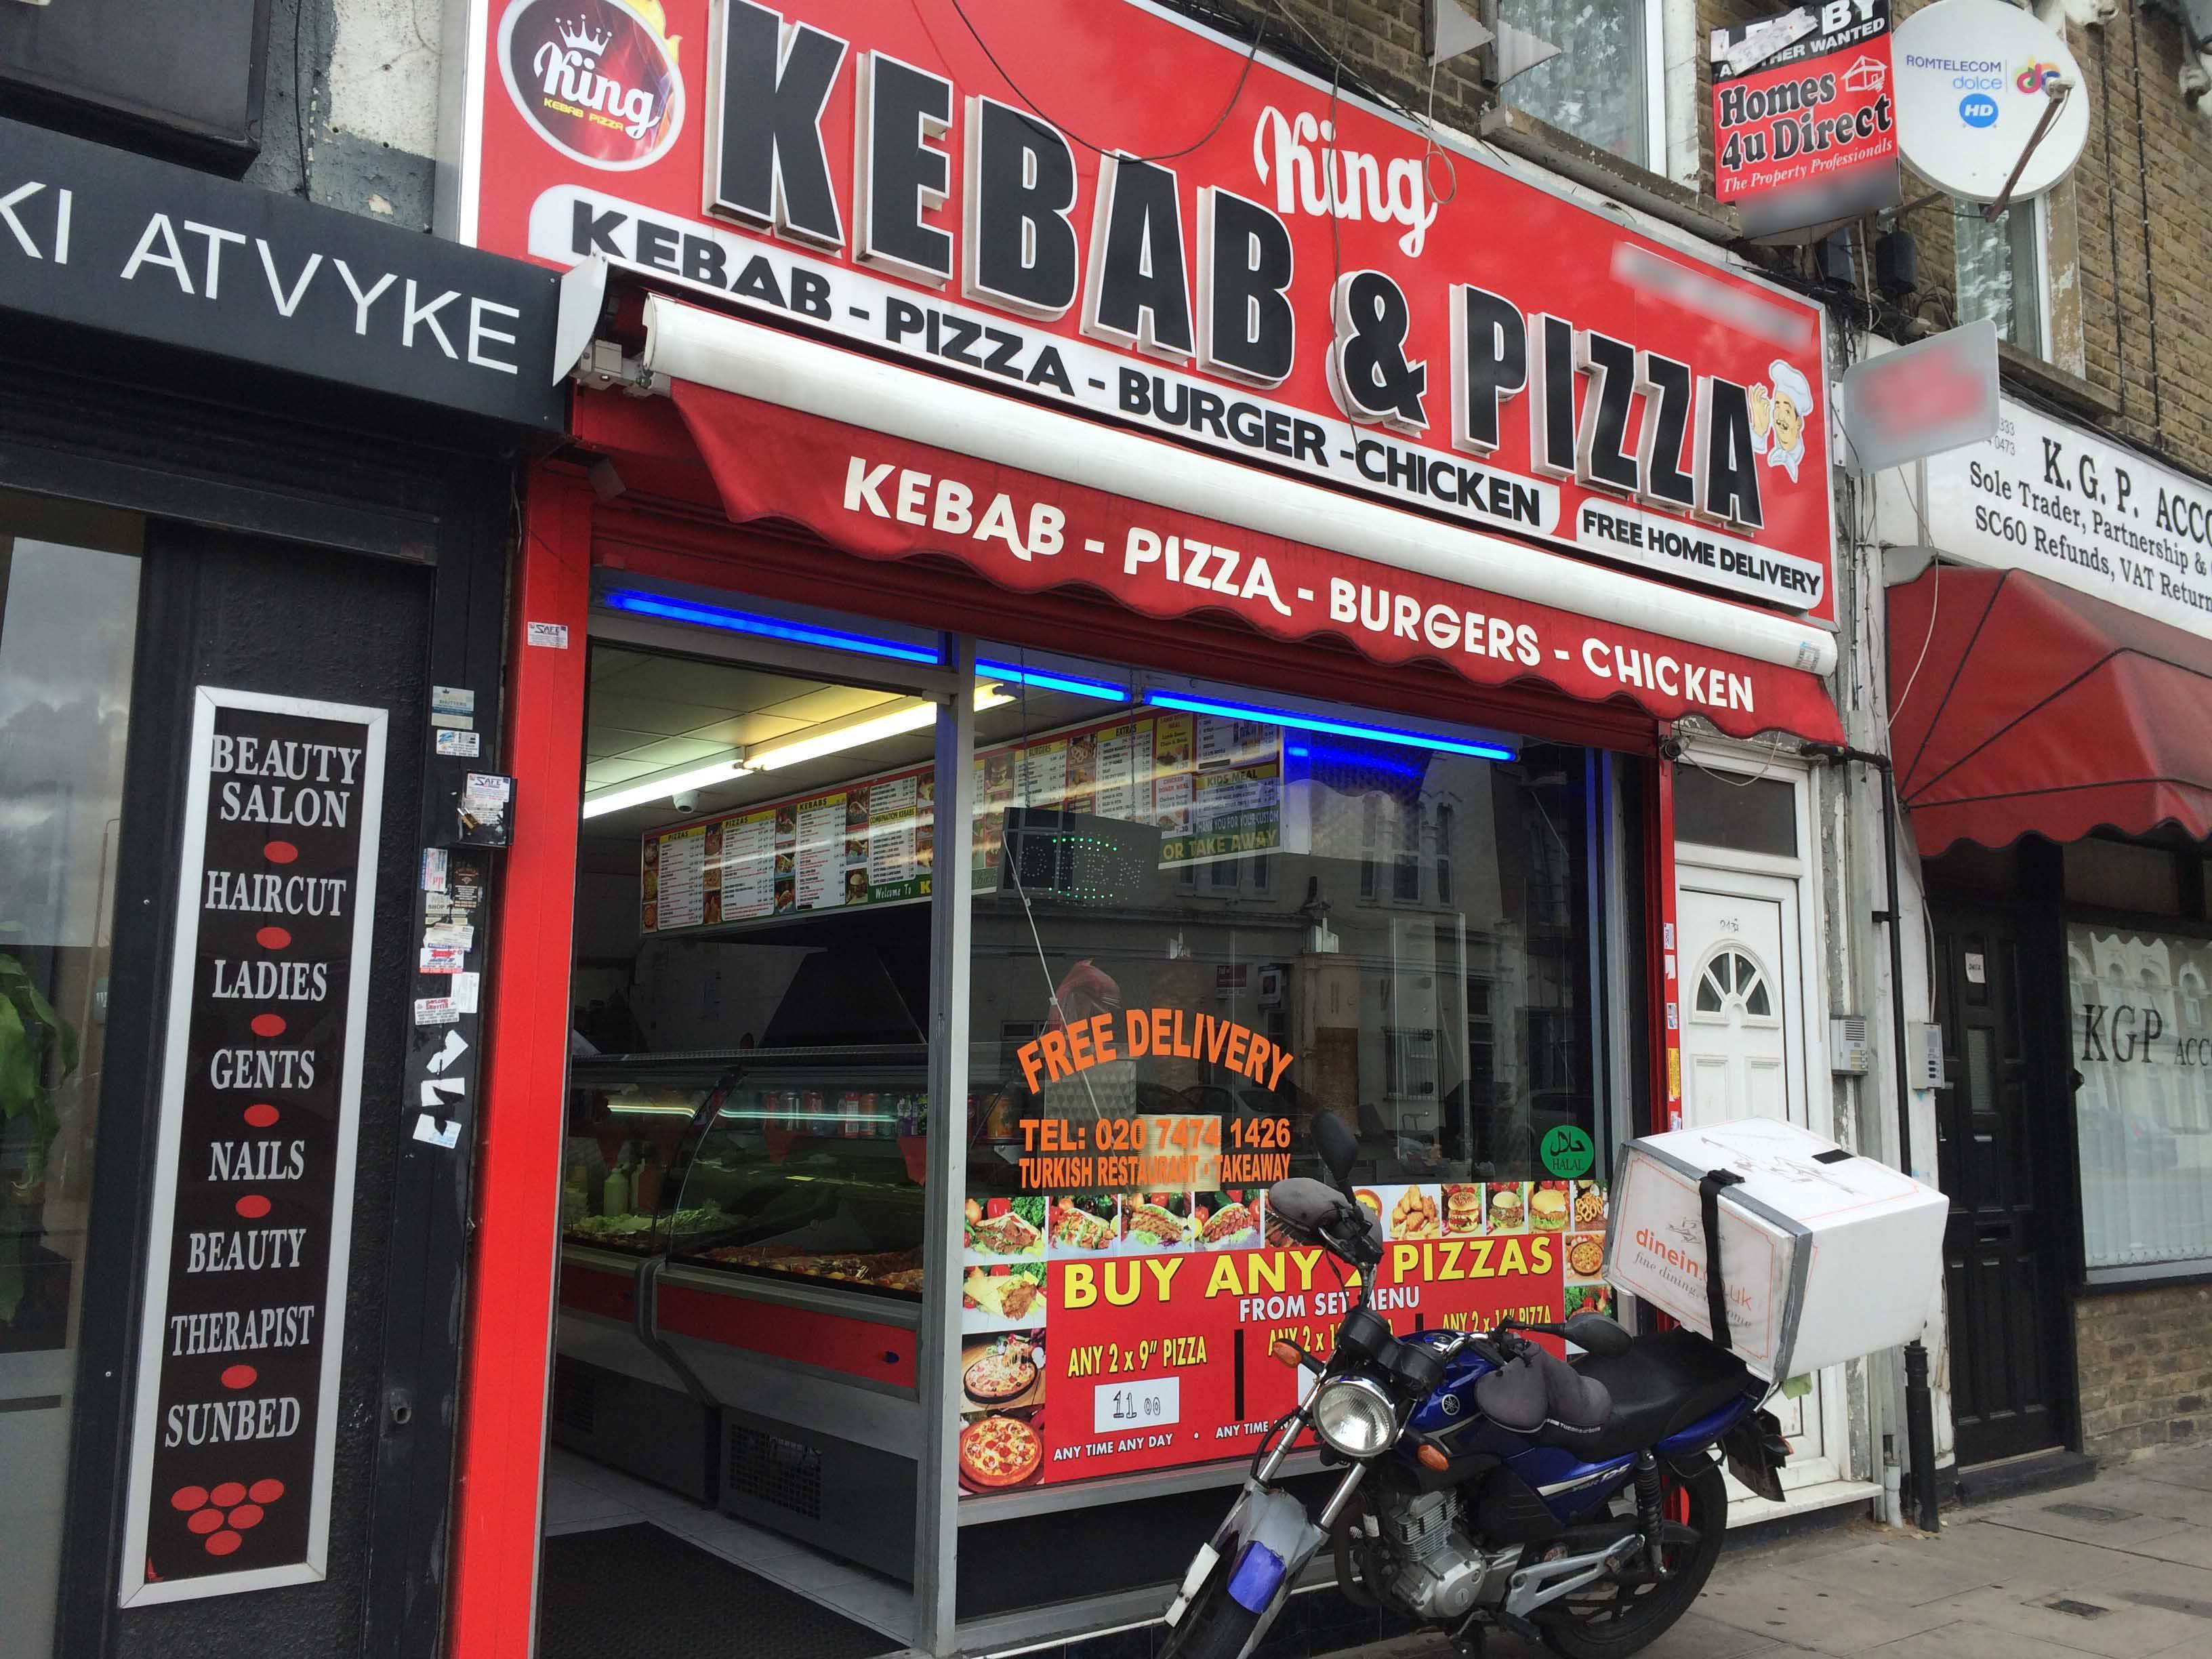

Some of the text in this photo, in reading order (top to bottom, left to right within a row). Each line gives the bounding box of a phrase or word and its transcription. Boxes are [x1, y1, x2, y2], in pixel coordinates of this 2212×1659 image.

[1719, 44, 1805, 77] AHER
[1810, 18, 1885, 54] WANTED
[1906, 54, 2002, 73] ROMTELECOM
[533, 41, 661, 140] King
[1719, 73, 1836, 128] Homes
[1952, 76, 2003, 90] dolce
[544, 97, 624, 132] KEBAB PIZZA
[1965, 104, 1994, 117] HD
[1721, 94, 1893, 173] 4u Direct
[1253, 104, 1439, 258] King
[1723, 138, 1893, 192] The Property Professionals
[705, 0, 1764, 533] KEBAB & PIZZA
[119, 213, 520, 375] ATVYKE
[572, 200, 832, 322] KEBAB
[885, 296, 1076, 396] PIZZA
[1118, 366, 1328, 468] BURGER
[1994, 434, 2016, 456] 0473
[1969, 462, 2012, 500] Sole
[2018, 480, 2087, 535] Trader,
[2092, 510, 2188, 575] Partnership
[2194, 552, 2207, 576] &
[1582, 510, 1821, 596] FREE HOME DELIVERY
[1975, 505, 2027, 546] SC60
[2033, 526, 2115, 582] Refunds,
[2119, 557, 2154, 592] VAT
[842, 456, 1066, 562] KEBAB
[1123, 526, 1292, 617] PIZZA
[1330, 577, 1540, 667] BURGERS
[1582, 637, 1755, 713] CHICKEN
[1029, 745, 1052, 756] BURGERS
[1115, 724, 1137, 739] EXTRAS
[209, 734, 362, 785] BEAUTY
[1207, 769, 1257, 787] KIDS MEAL
[475, 777, 501, 787] SAFE
[220, 781, 351, 829] SALON
[725, 817, 748, 827] PIZZAS
[799, 797, 827, 811] KEBABS
[1196, 819, 1213, 834] THANK
[1214, 818, 1227, 830] YOU
[1227, 816, 1240, 828] FOR
[668, 831, 689, 841] PIZZAS
[1163, 829, 1277, 860] OR TAKE AWAY
[205, 871, 347, 917] HAIRCUT
[875, 883, 912, 899] Welcome To
[211, 959, 328, 1002] LADIES
[1017, 1008, 1294, 1094] FREE DELIVERY
[2082, 1004, 2212, 1067] KGP ACC
[210, 1048, 315, 1090] GENTS
[1019, 1118, 1290, 1151] TEL: 020 7474 1426
[1550, 1129, 1586, 1157] حلال
[207, 1140, 306, 1182] NAILS
[1019, 1153, 1291, 1189] TURKISH RESTAURANT TAKEAWAY
[1552, 1158, 1584, 1171] HALAL
[186, 1228, 307, 1273] BEAUTY
[1633, 1252, 1656, 1270] fine
[1064, 1257, 1185, 1310] BUY
[1204, 1249, 1324, 1299] ANY
[1393, 1237, 1554, 1285] PIZZAS
[1239, 1294, 1306, 1323] FROM
[1314, 1291, 1349, 1316] SET
[1442, 1311, 1469, 1332] ANY
[1471, 1310, 1479, 1332] 2
[1483, 1317, 1490, 1333] x
[1519, 1305, 1552, 1328] PIZZA
[170, 1305, 315, 1356] THERAPIST
[1302, 1325, 1311, 1353] 2
[1315, 1332, 1325, 1352] x
[1067, 1345, 1103, 1378] ANY
[1108, 1344, 1118, 1373] 2
[1124, 1351, 1134, 1372] x
[1163, 1336, 1208, 1368] PIZZA
[164, 1396, 301, 1448] SUNBED
[1215, 1425, 1240, 1439] ANY
[1244, 1420, 1269, 1435] TIME
[1053, 1433, 1174, 1461] ANY TIME ANY DAY
